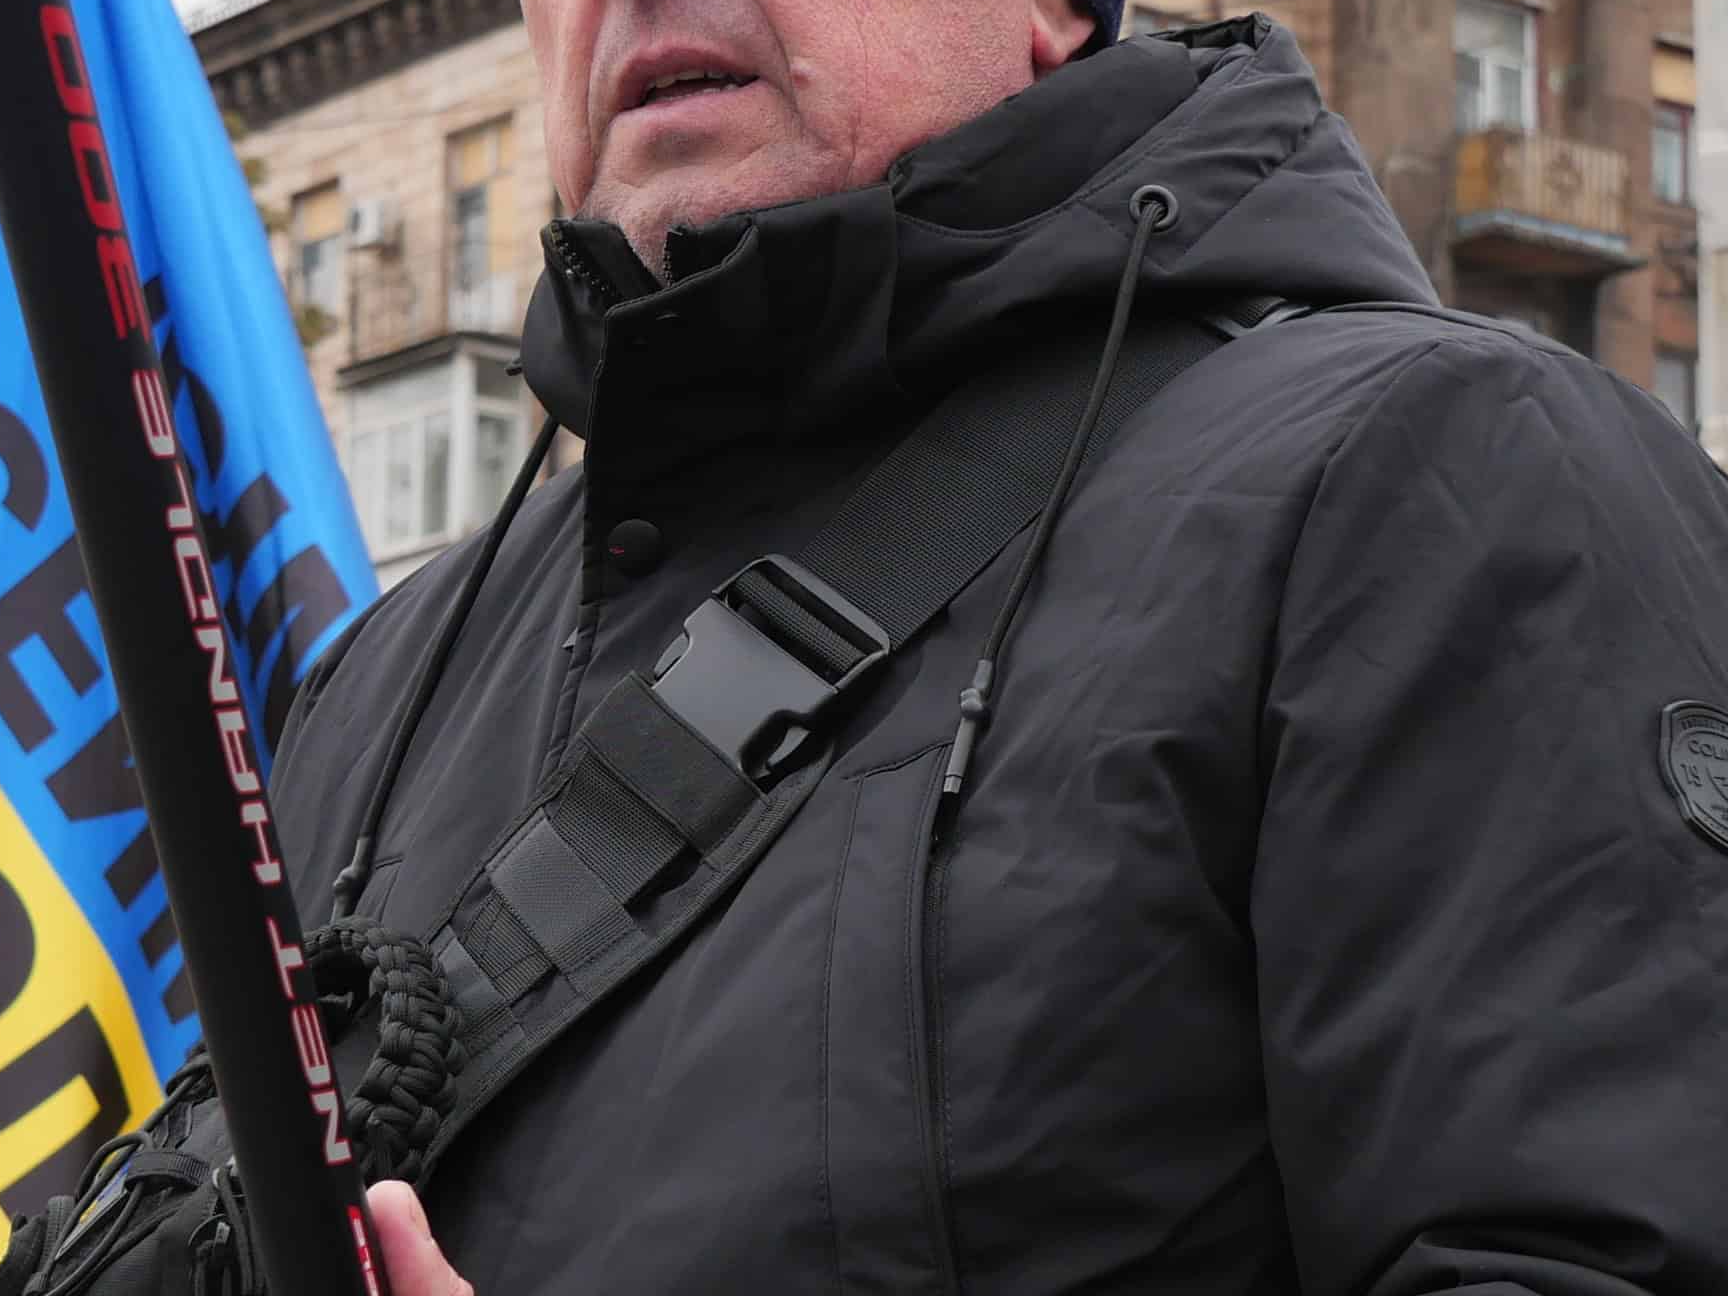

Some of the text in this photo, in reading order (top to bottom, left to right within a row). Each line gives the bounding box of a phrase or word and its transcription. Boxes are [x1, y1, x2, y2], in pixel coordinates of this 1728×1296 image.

[38, 3, 152, 341] 300
[131, 368, 282, 885] HANDLE
[266, 914, 354, 1165] NET
